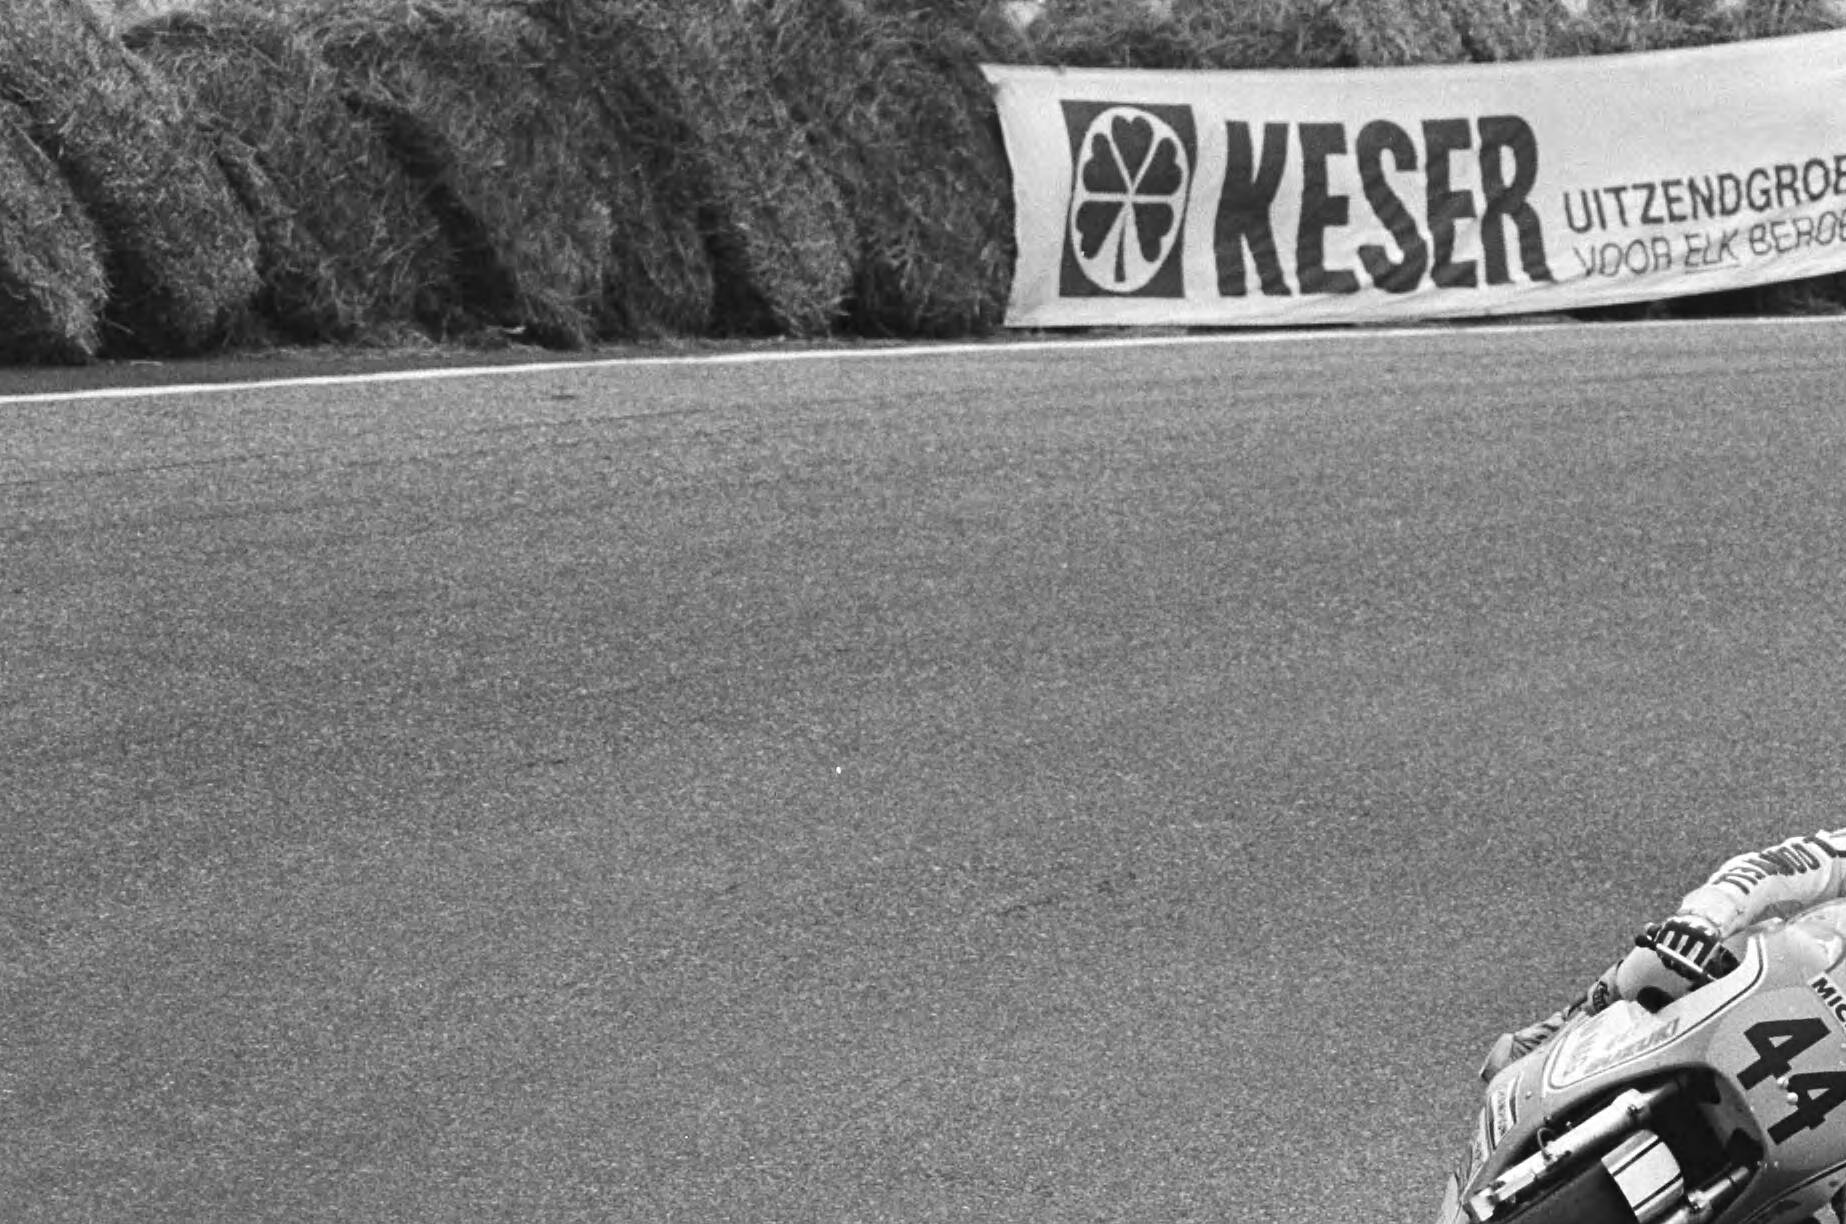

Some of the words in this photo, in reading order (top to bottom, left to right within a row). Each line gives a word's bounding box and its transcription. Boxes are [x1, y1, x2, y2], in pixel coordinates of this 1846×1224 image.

[1213, 115, 1557, 297] KESER
[1572, 237, 1673, 279] VOOR
[1683, 228, 1740, 269] ELK
